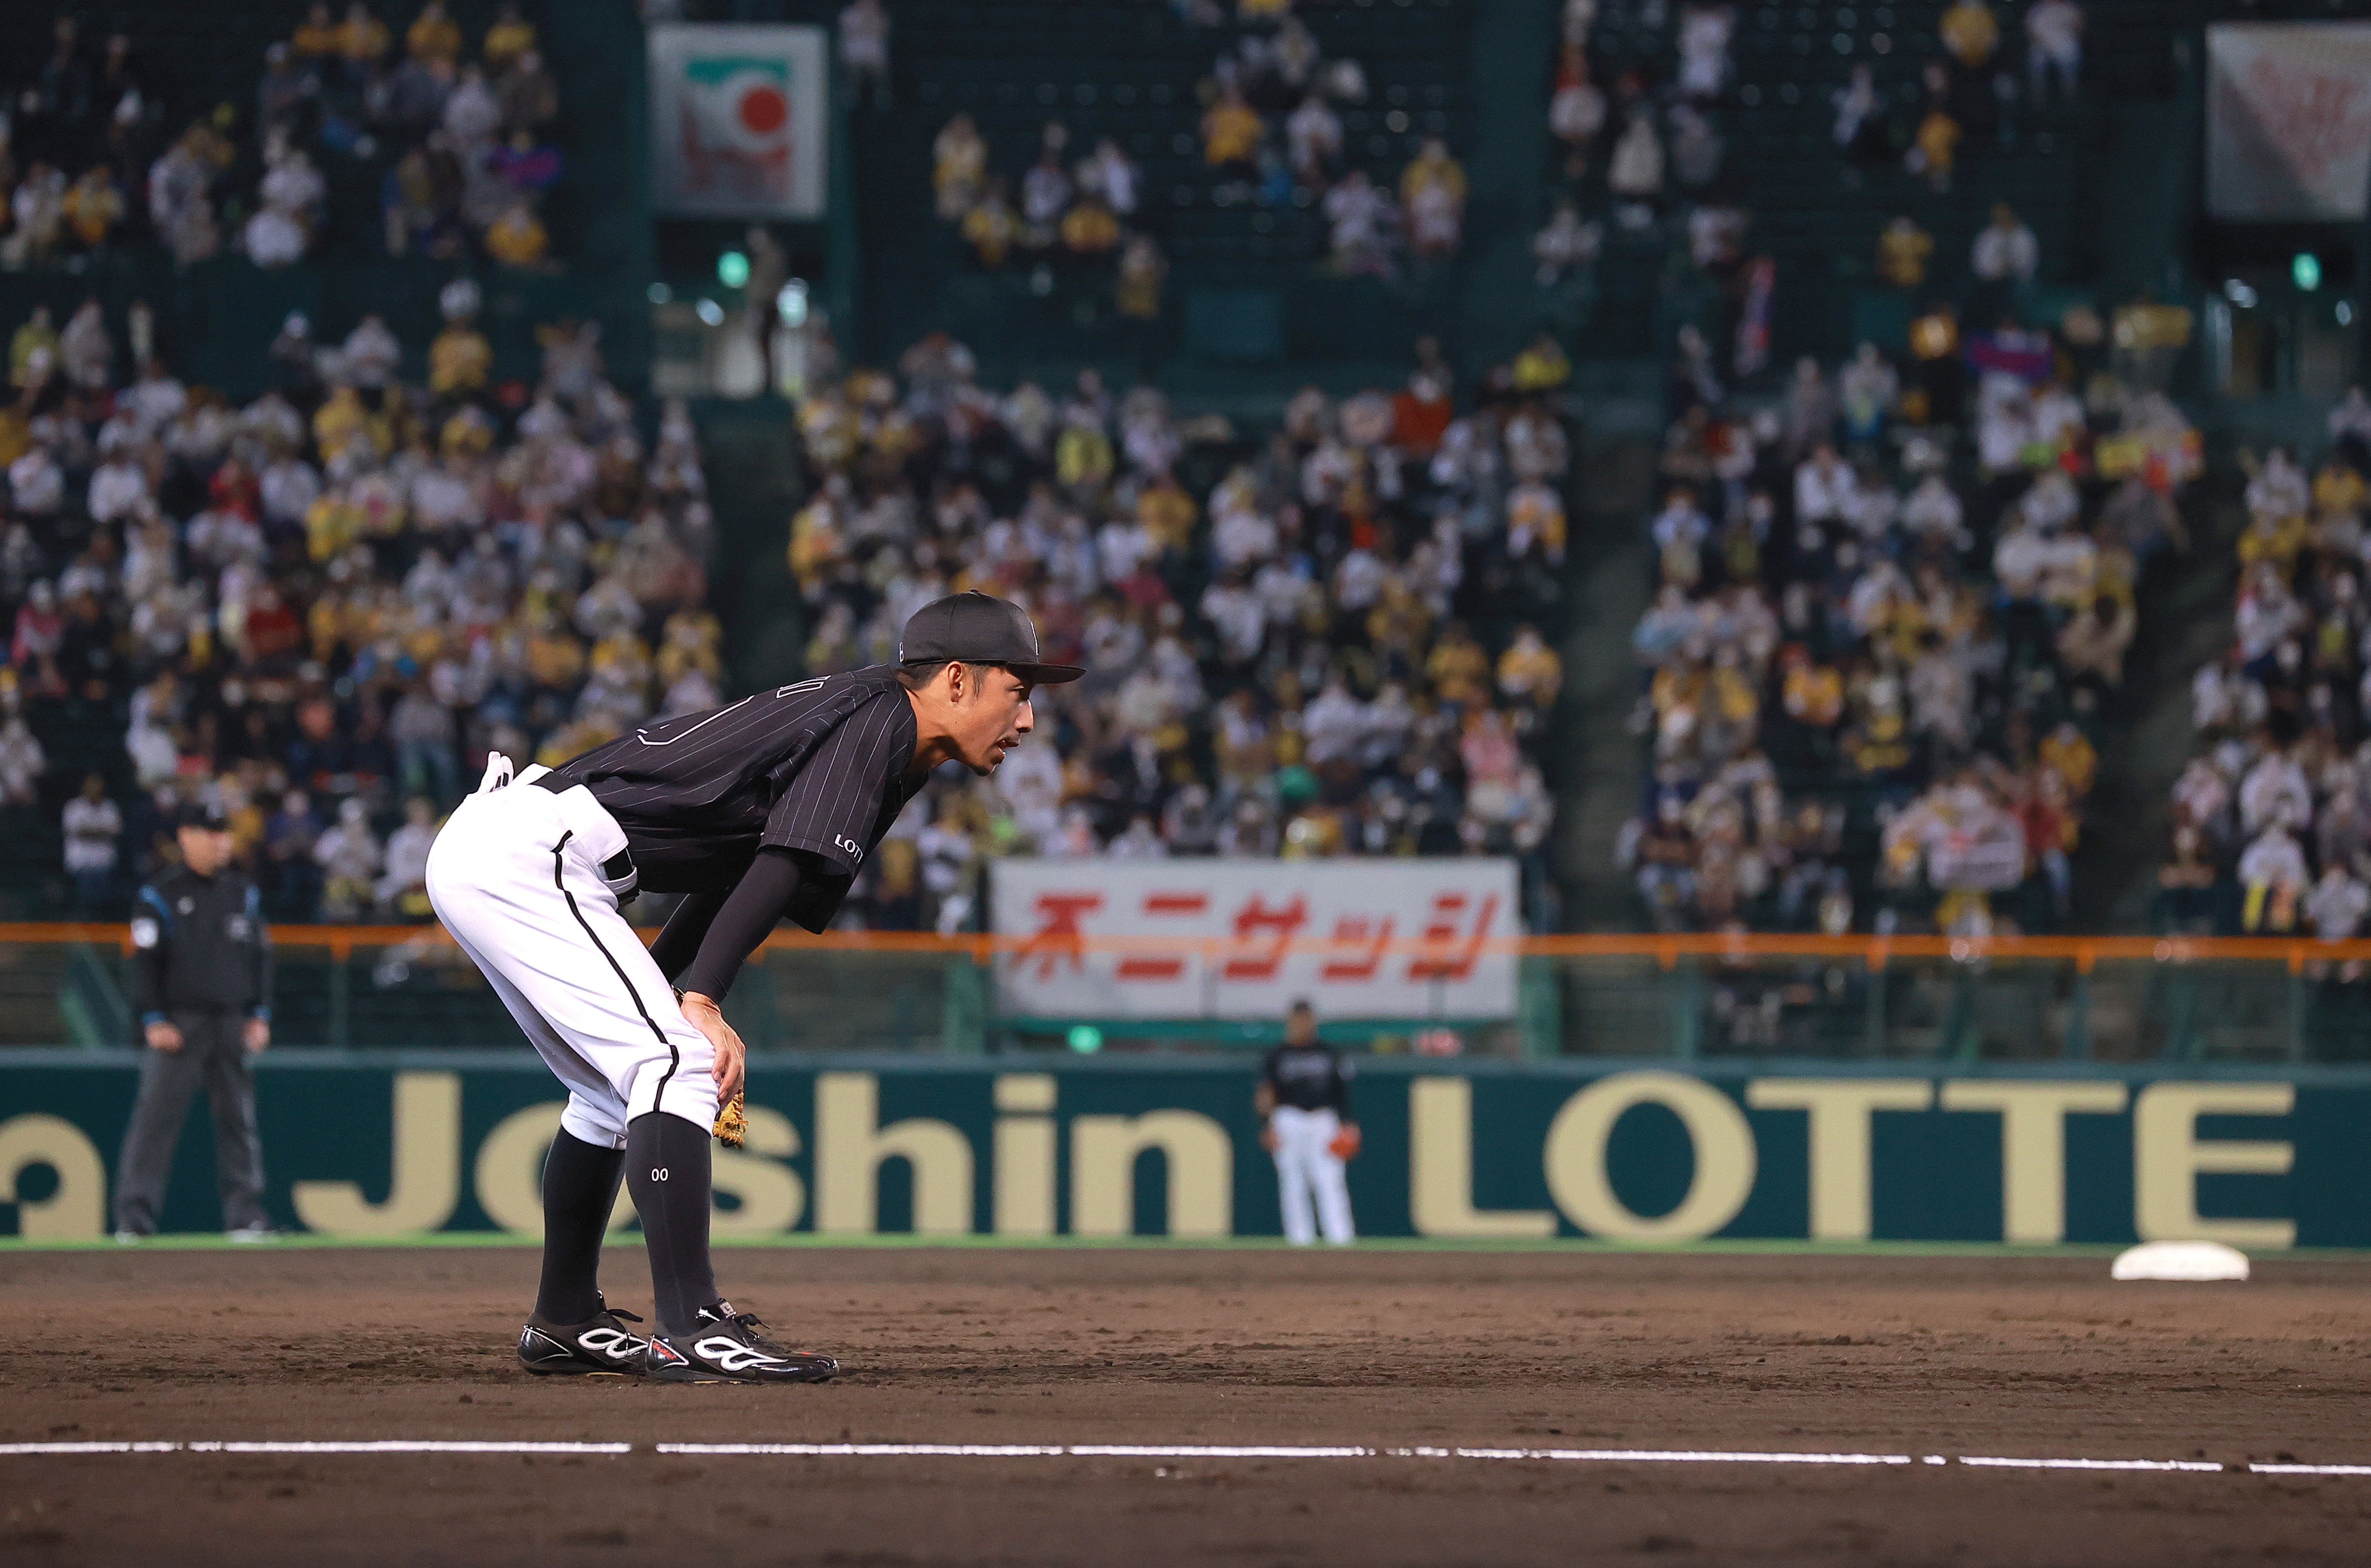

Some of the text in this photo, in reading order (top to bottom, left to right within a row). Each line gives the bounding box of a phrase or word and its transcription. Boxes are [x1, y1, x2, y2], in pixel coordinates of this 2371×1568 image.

[1007, 892, 1498, 982] 不二サッシ
[291, 1071, 1235, 1242] Joshin
[651, 1168, 668, 1182] 00
[1407, 1070, 2297, 1249] LOTTE
